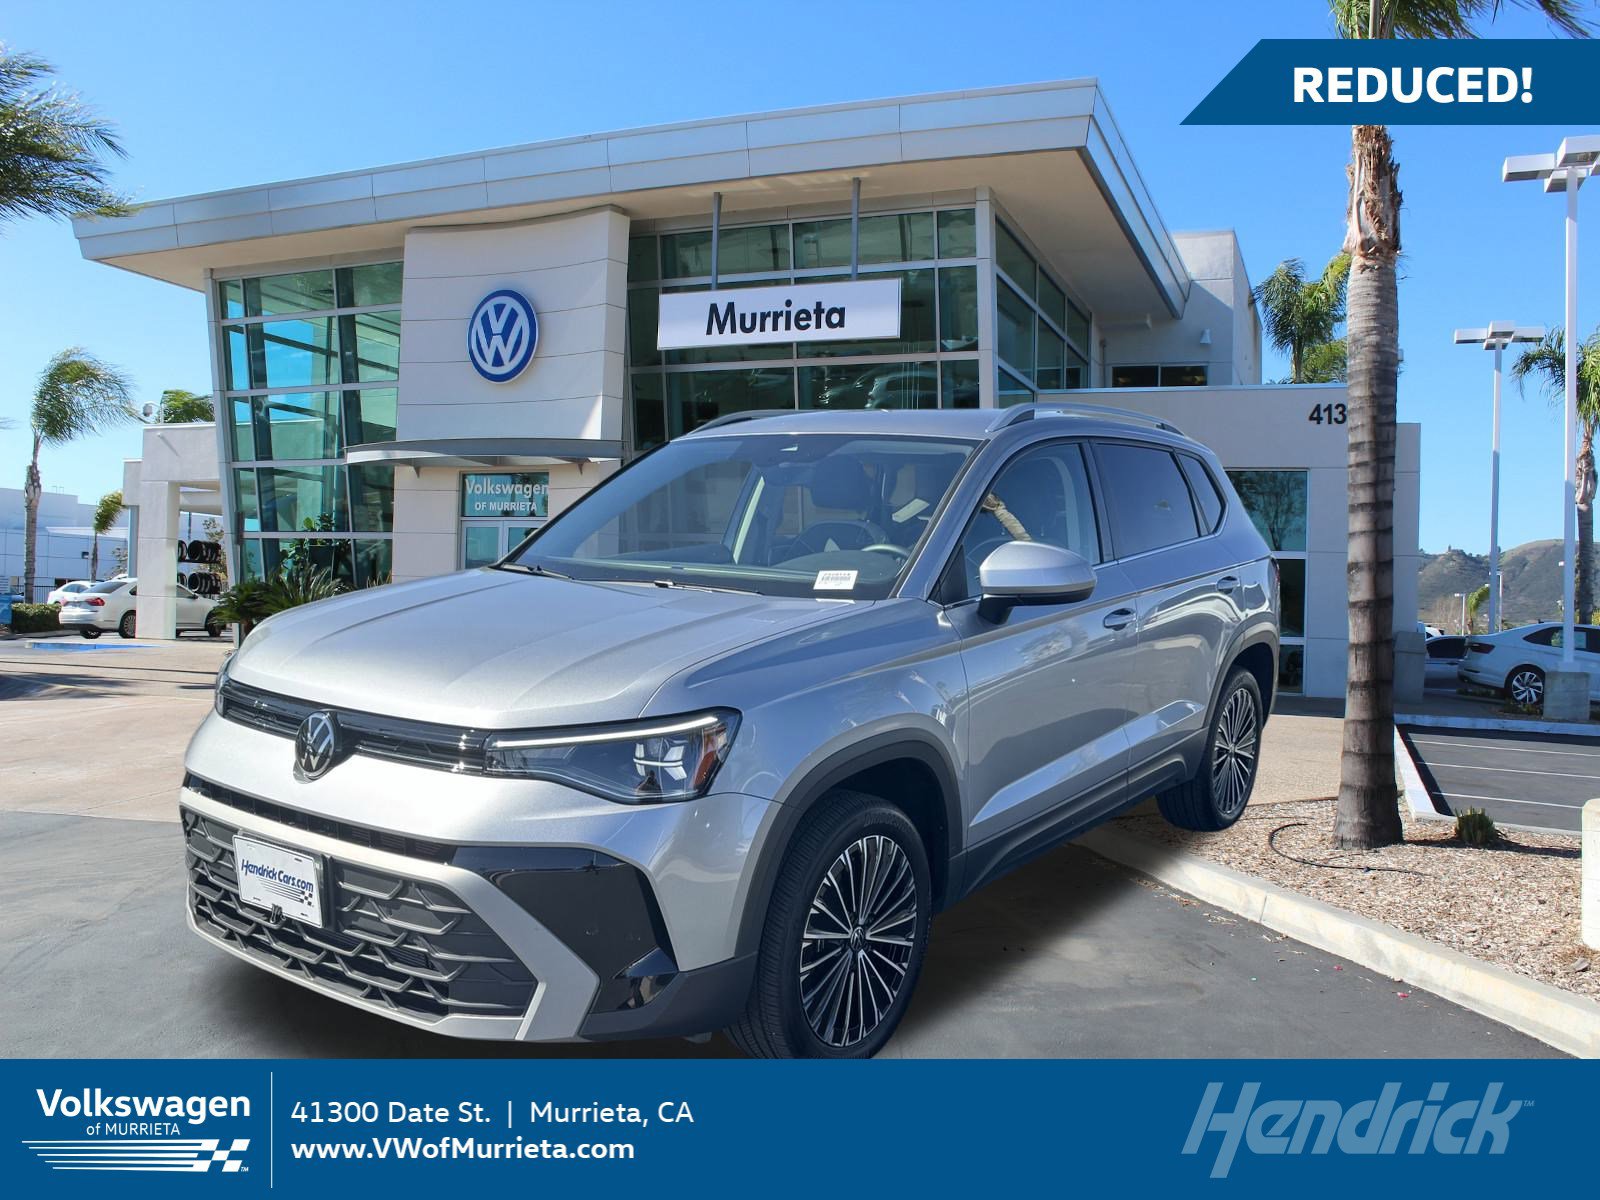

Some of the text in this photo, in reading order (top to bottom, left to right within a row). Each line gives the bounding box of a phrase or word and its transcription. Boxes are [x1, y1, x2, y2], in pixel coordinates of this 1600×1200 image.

[705, 298, 846, 336] Murrieta
[465, 478, 550, 498] Volkswagen
[474, 502, 537, 511] OF MURRIETA
